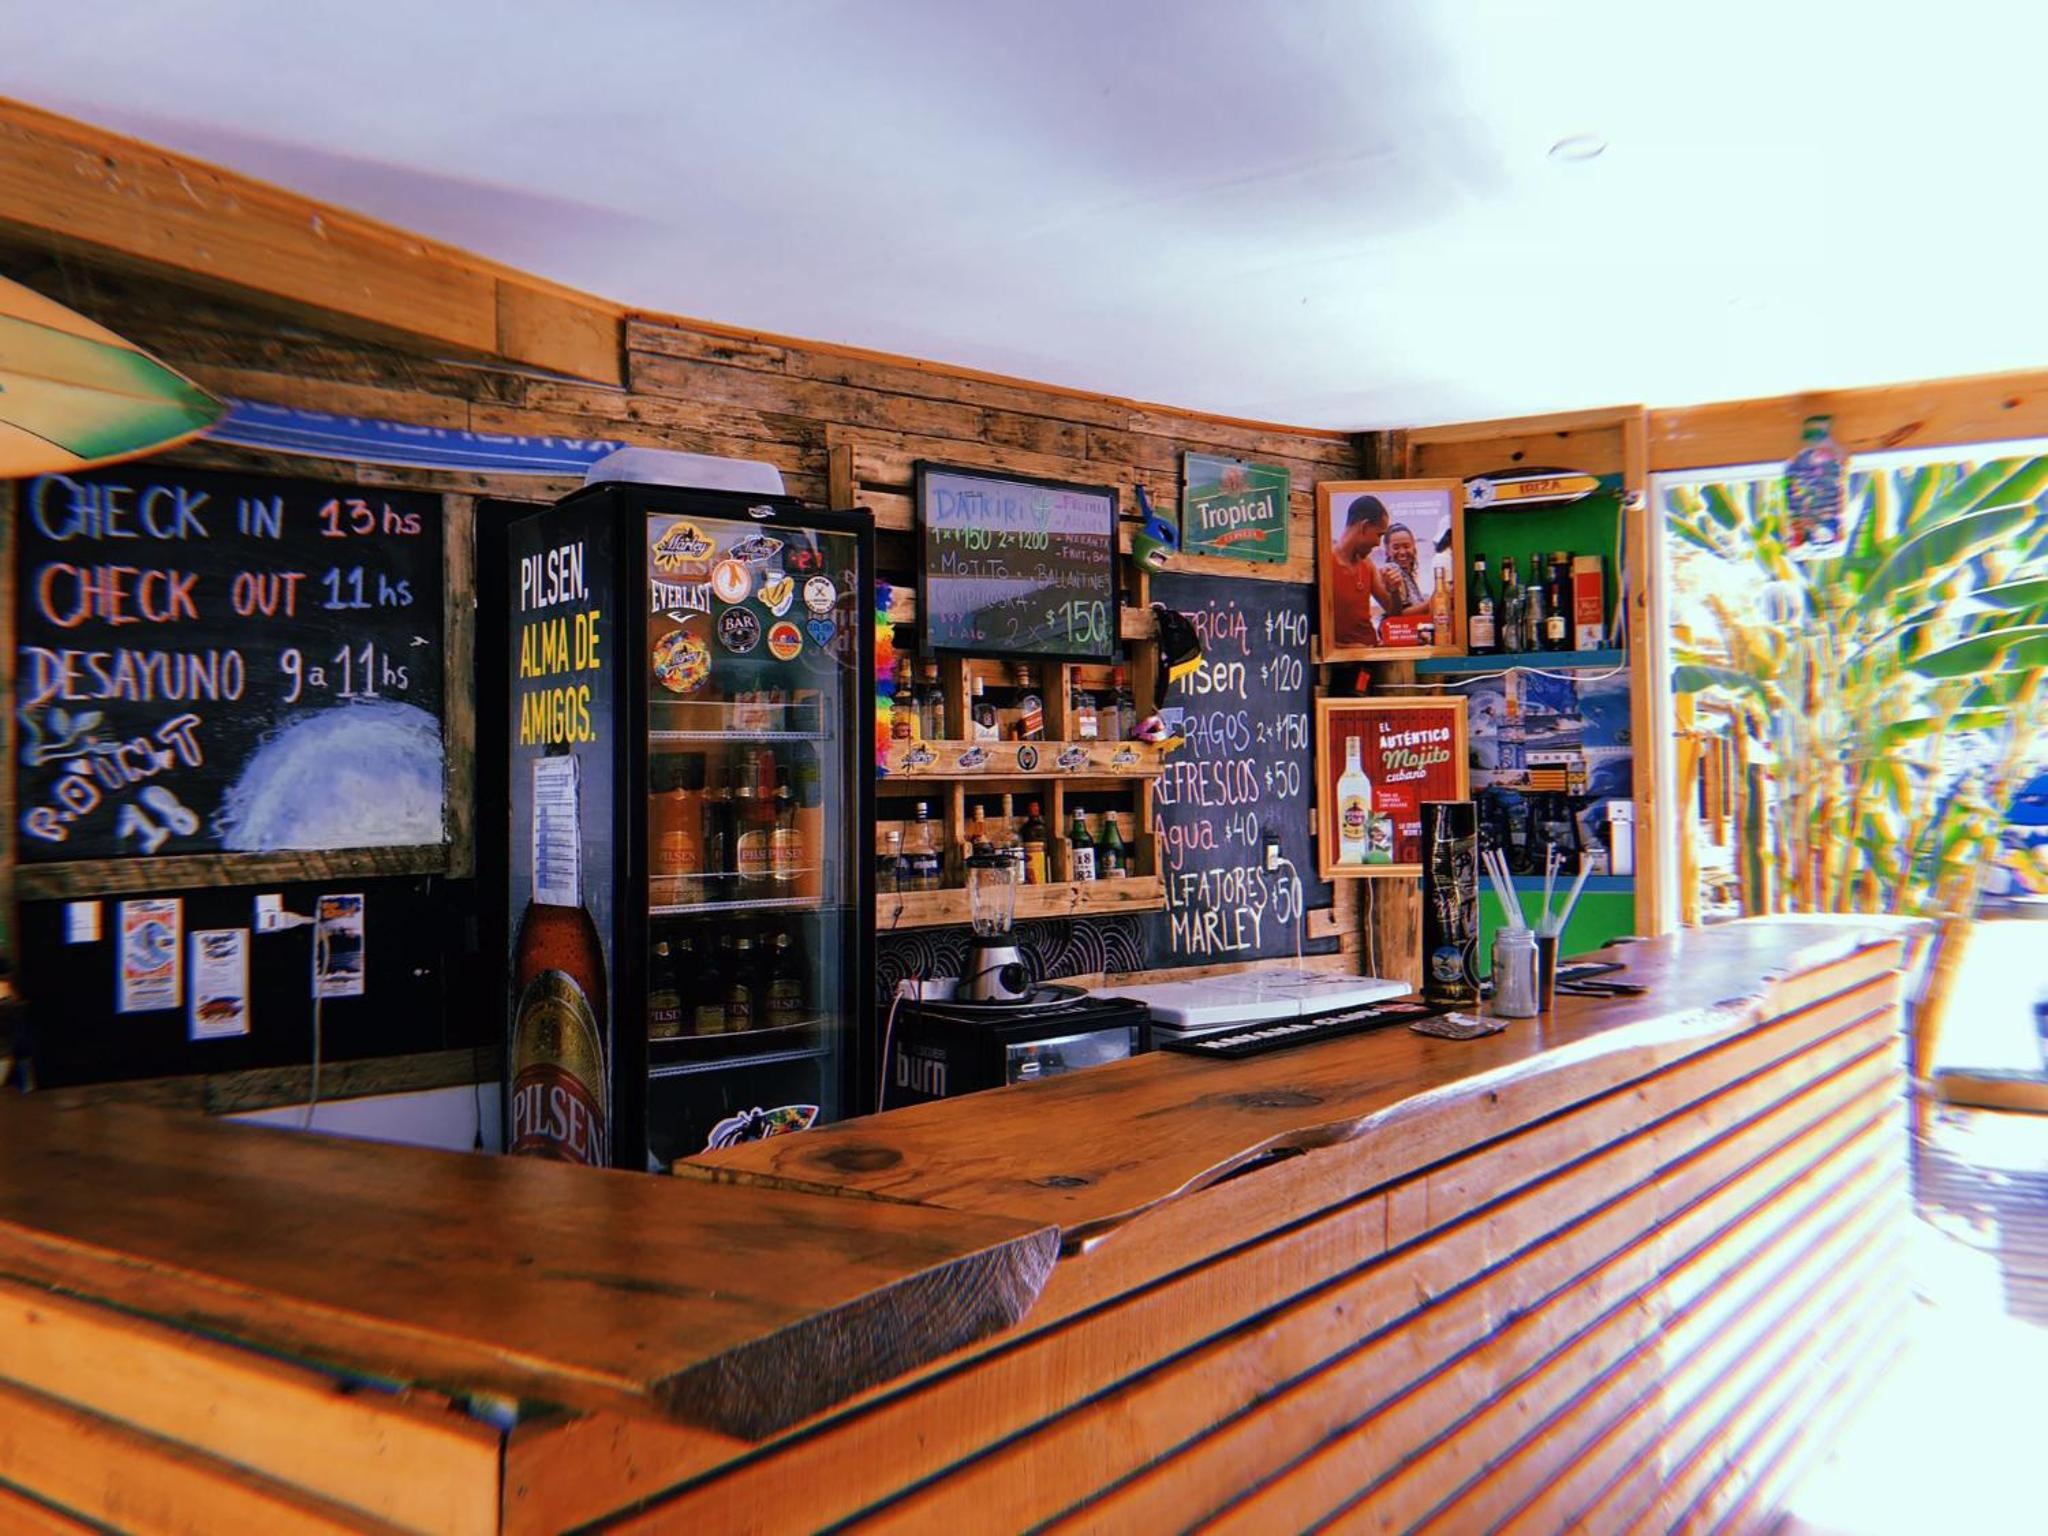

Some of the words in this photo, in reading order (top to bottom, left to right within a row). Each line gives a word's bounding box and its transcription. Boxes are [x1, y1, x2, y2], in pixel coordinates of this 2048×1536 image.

[32, 473, 210, 541] CHECK
[239, 496, 283, 539] IN
[1519, 480, 1562, 494] IBIZA
[1197, 495, 1274, 529] Tropical
[664, 531, 708, 557] Marley
[39, 563, 199, 628] CHECK
[232, 572, 306, 618] OUT
[521, 541, 589, 611] PILSEN,
[651, 578, 712, 614] EVERLAST
[520, 617, 570, 679] ALMA
[574, 610, 601, 671] DE
[725, 616, 755, 630] BAR
[1150, 601, 1251, 656] RICIA
[1265, 608, 1309, 647] $140
[20, 645, 245, 701] DESAYUNO
[1260, 654, 1303, 692] $120
[520, 684, 597, 745] AMIGOS.
[1171, 711, 1252, 758] RAGOS
[1379, 721, 1391, 733] EL
[1380, 727, 1450, 749] AUTÉNTICO
[1265, 761, 1301, 799] $50
[1382, 745, 1451, 769] Mojito
[1386, 768, 1427, 783] cubano
[1155, 813, 1219, 871] Agua
[1225, 811, 1259, 847] $40
[1165, 865, 1268, 913] LFAJORES
[1172, 906, 1263, 956] MARLEY
[896, 1041, 946, 1097] burn
[510, 1083, 604, 1168] PILSEN
